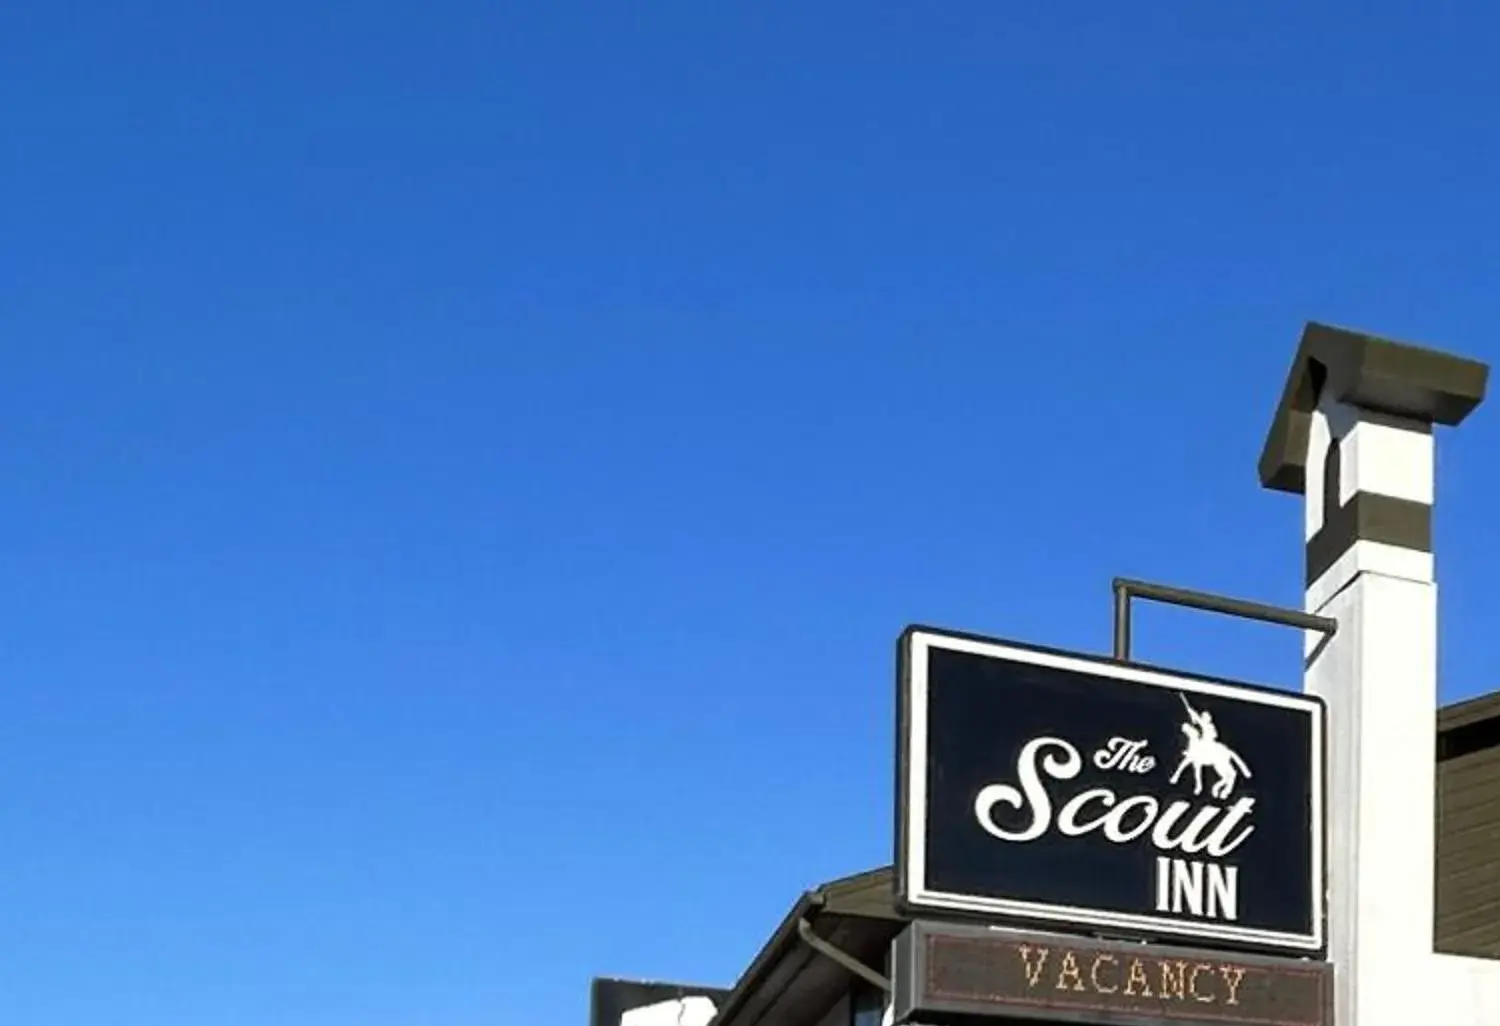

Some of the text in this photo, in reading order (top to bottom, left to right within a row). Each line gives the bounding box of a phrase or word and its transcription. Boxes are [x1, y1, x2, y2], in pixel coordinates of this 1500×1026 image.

[1093, 736, 1157, 774] The
[974, 737, 1256, 858] Scout
[1155, 856, 1239, 920] INN
[1018, 944, 1247, 1006] VACANCY
